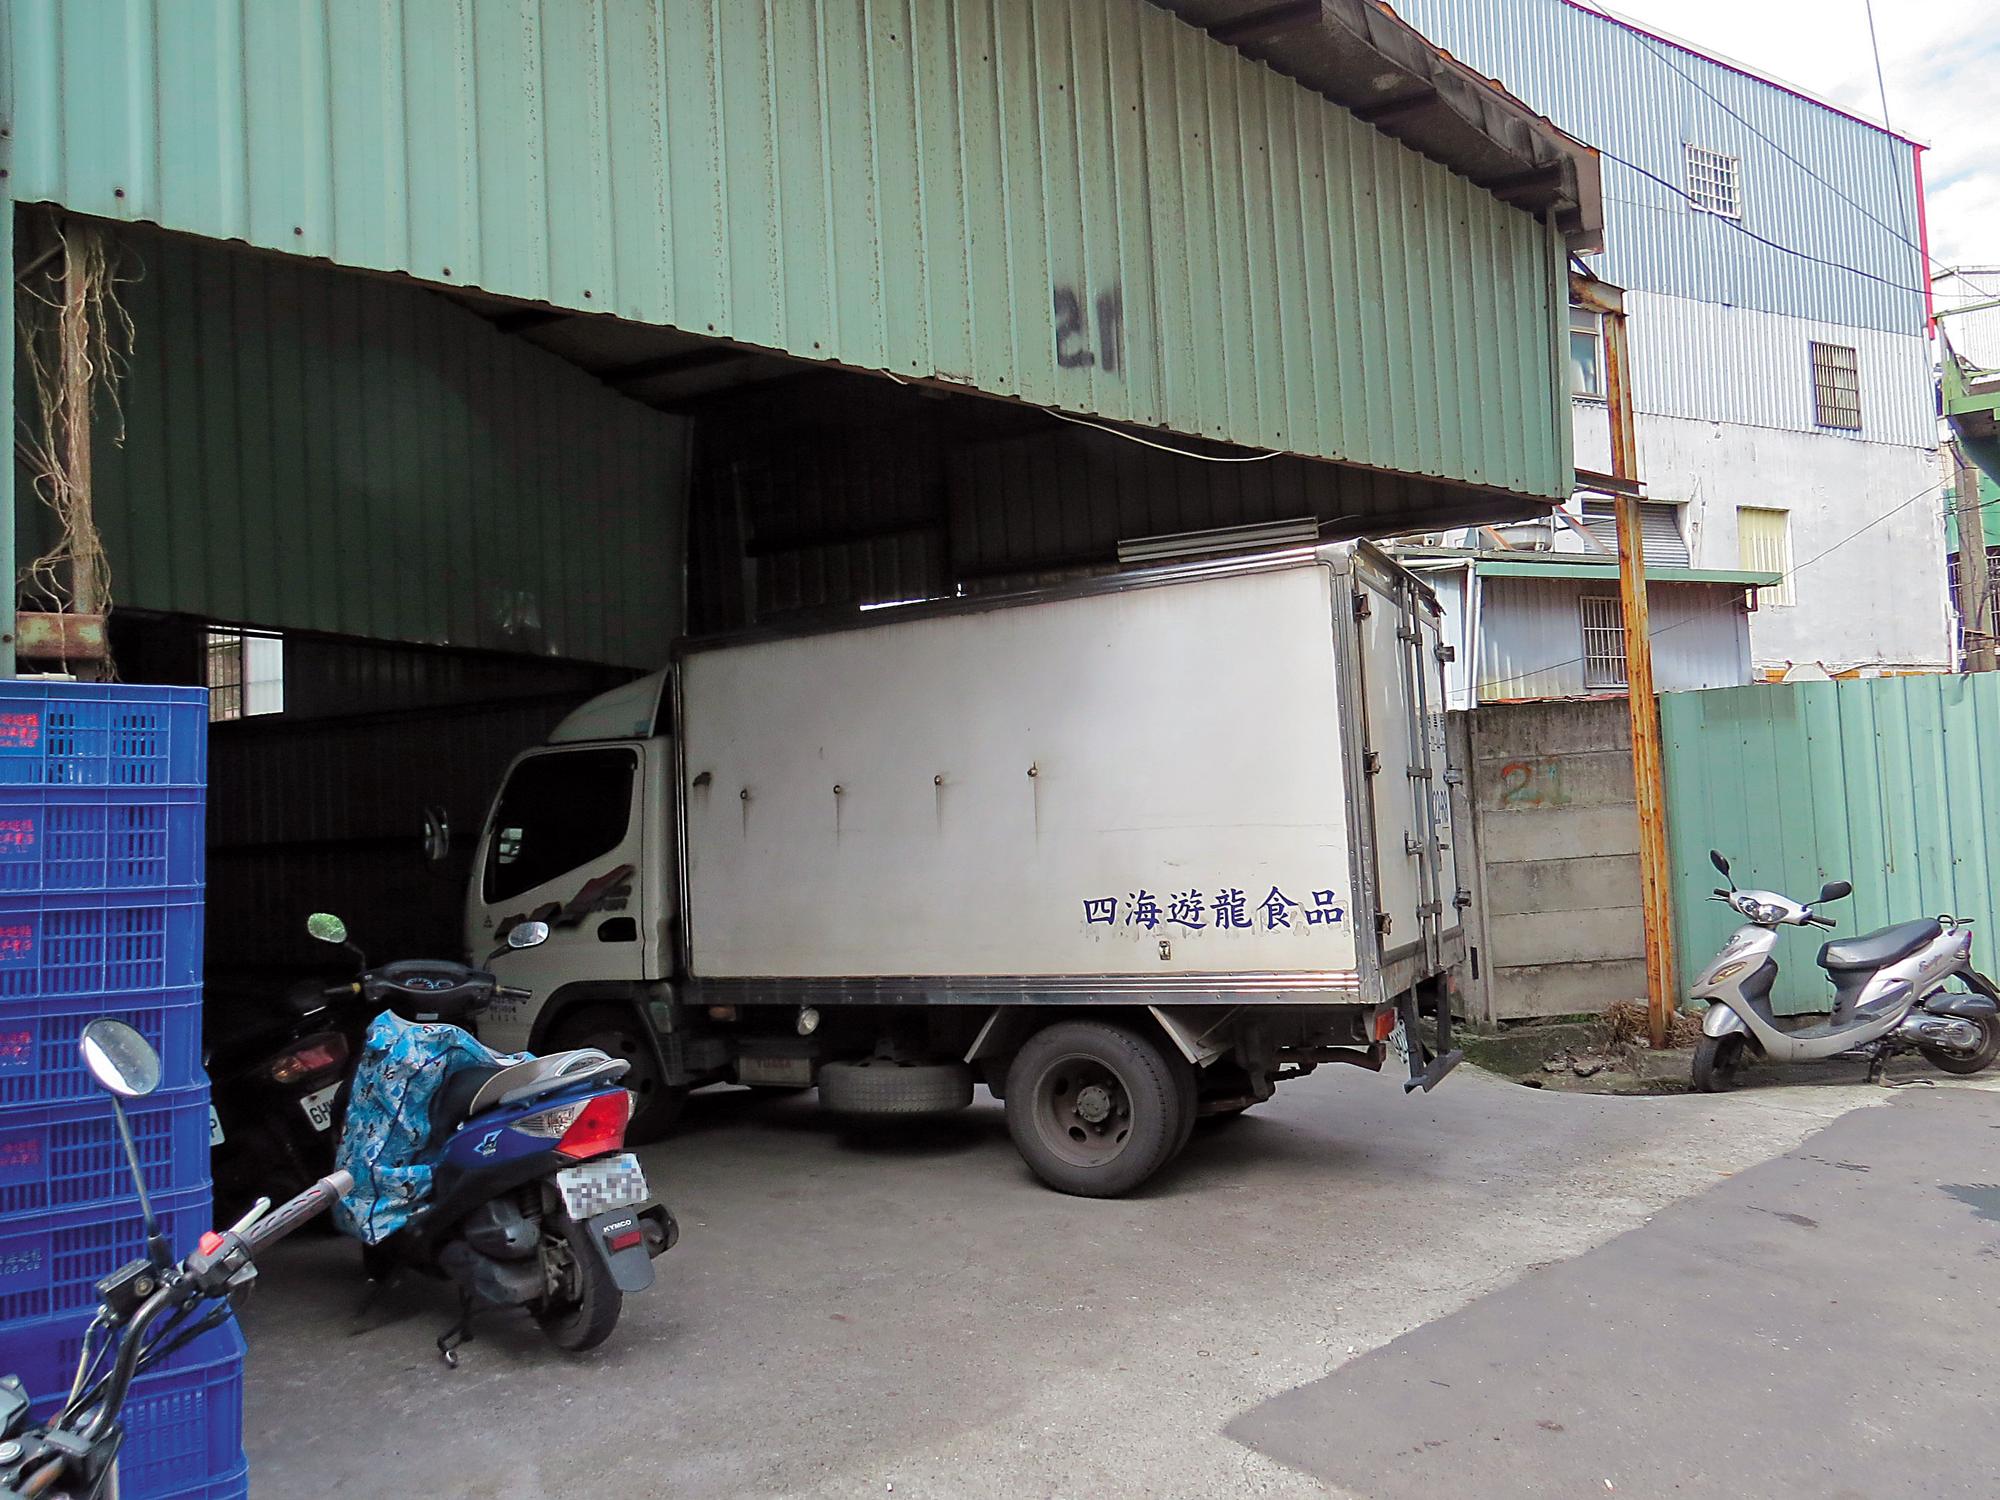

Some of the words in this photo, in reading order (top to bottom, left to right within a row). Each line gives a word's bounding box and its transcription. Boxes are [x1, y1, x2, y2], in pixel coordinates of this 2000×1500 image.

[1054, 286, 1124, 373] 21
[1083, 886, 1345, 931] 四海遊龍食品
[603, 1219, 632, 1233] KYMCO
